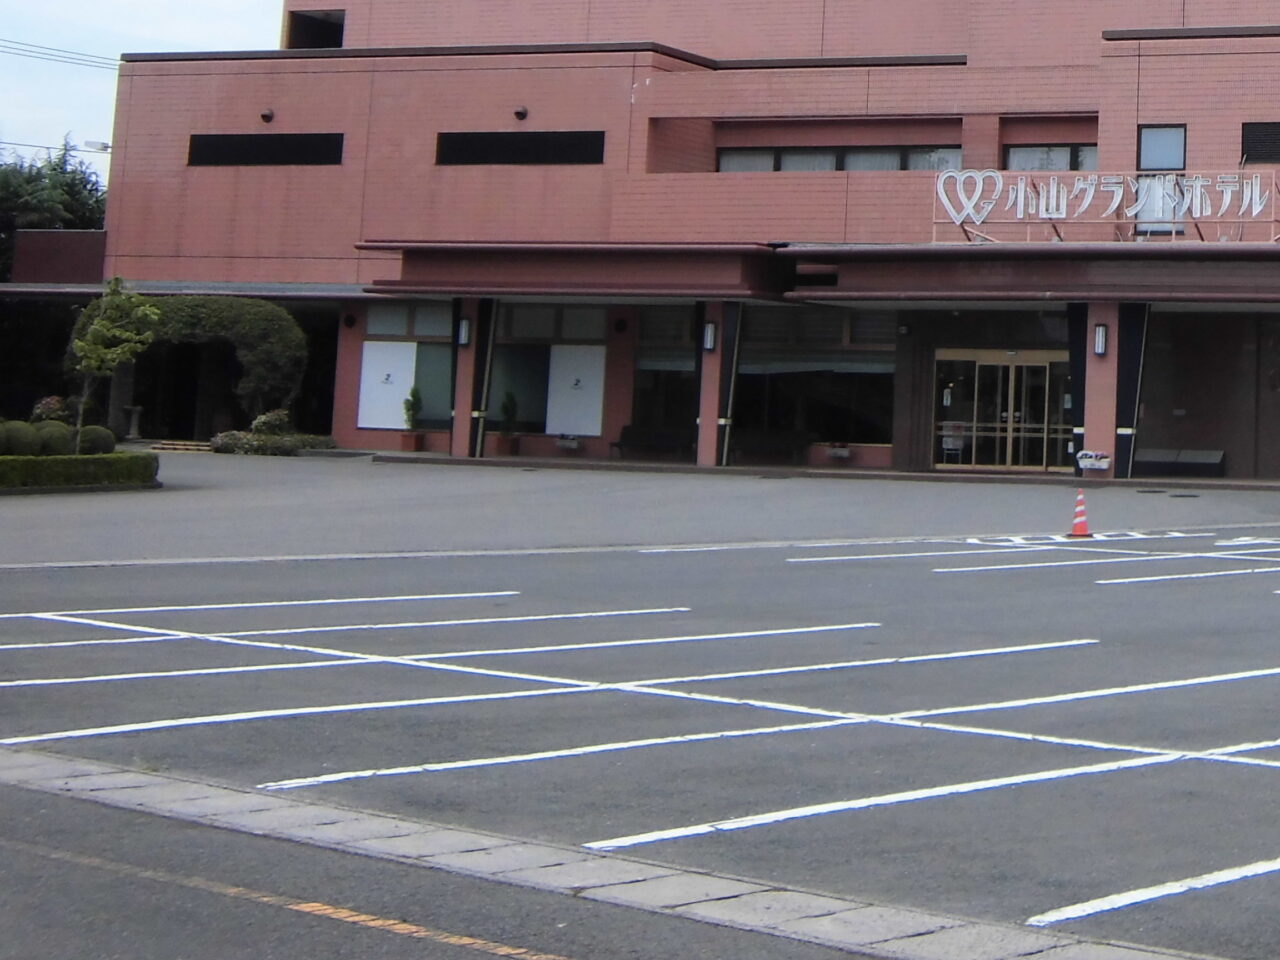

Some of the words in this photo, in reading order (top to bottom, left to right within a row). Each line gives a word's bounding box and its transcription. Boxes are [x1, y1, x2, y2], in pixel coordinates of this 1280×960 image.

[1004, 174, 1269, 219] 小山グランドホテル
